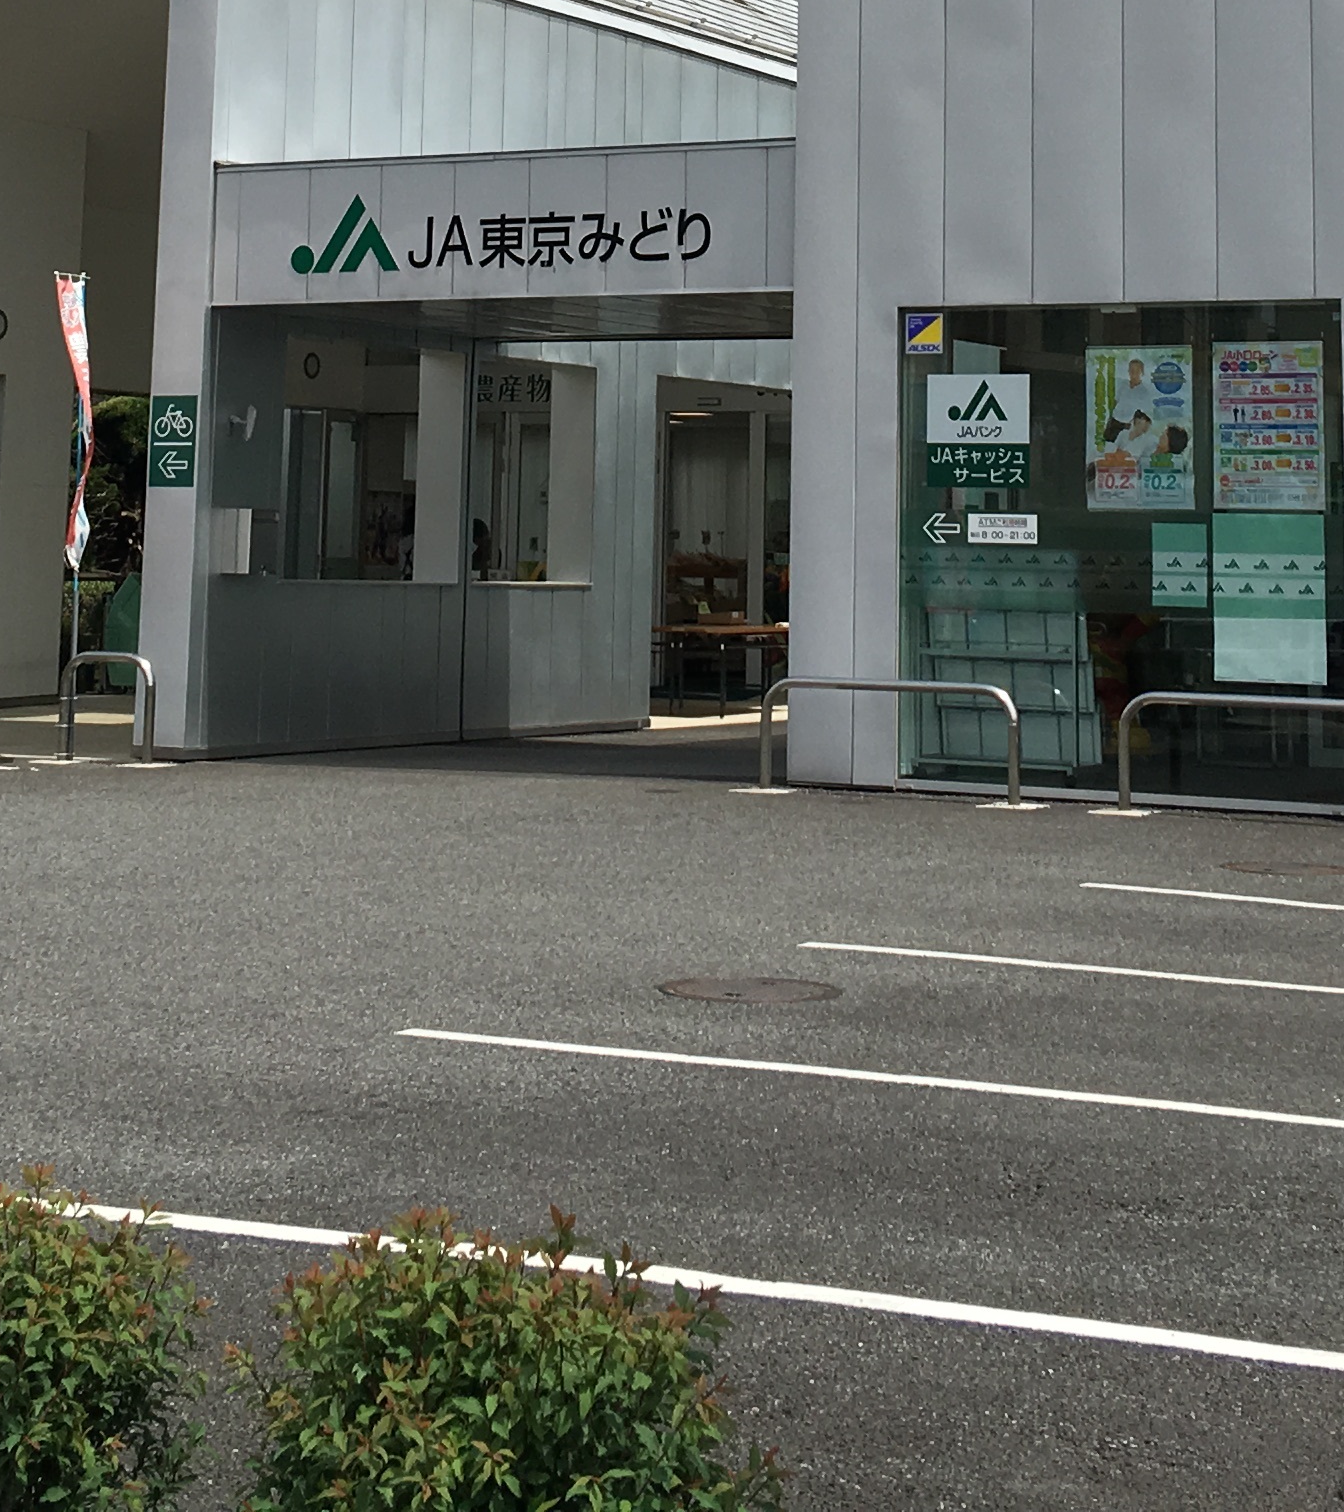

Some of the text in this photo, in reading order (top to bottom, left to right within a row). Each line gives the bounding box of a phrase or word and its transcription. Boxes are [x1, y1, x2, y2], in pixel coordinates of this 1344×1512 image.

[407, 207, 712, 269] JA東京みどり
[908, 344, 941, 352] ALSOK
[957, 426, 1002, 438] JAバンク
[931, 447, 1025, 465] JAキャッシュ
[953, 467, 1025, 484] サービス
